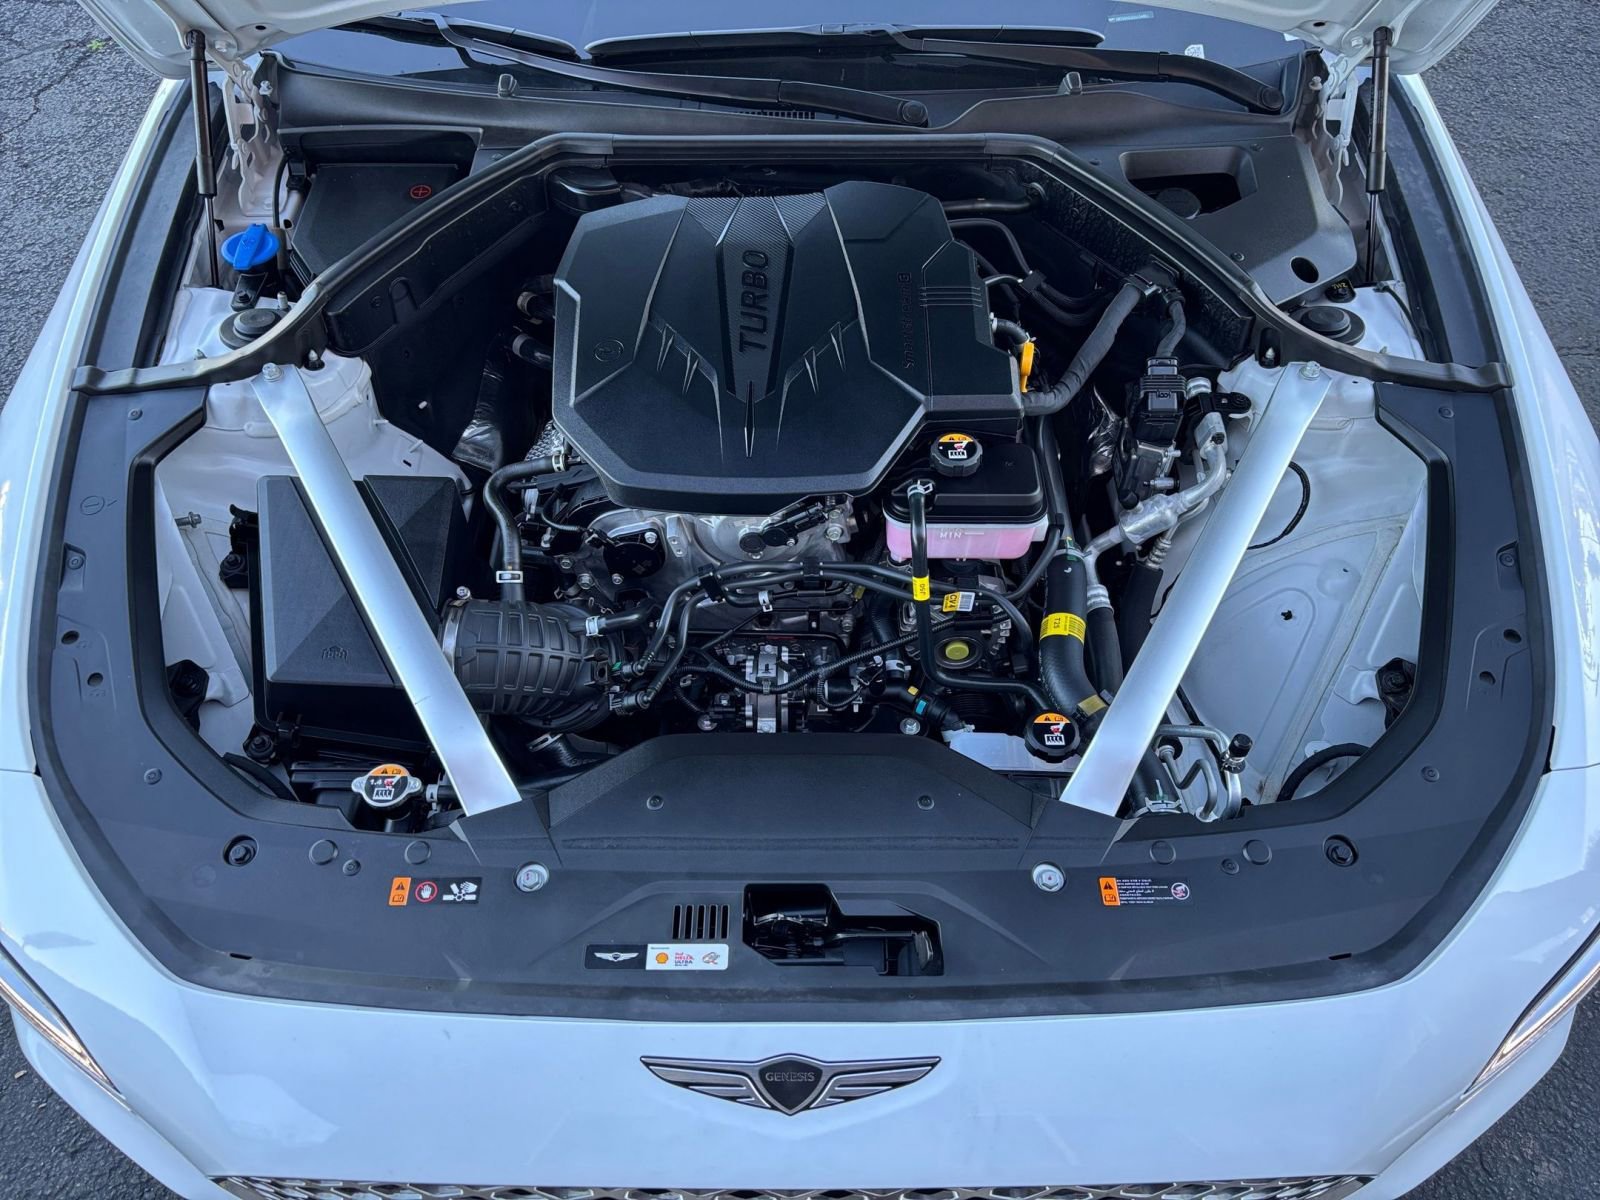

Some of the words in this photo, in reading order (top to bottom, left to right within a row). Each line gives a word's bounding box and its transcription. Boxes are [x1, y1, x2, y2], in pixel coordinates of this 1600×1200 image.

[739, 249, 769, 352] TURBO
[949, 594, 957, 608] CV4
[765, 1071, 816, 1082] GENESIS
